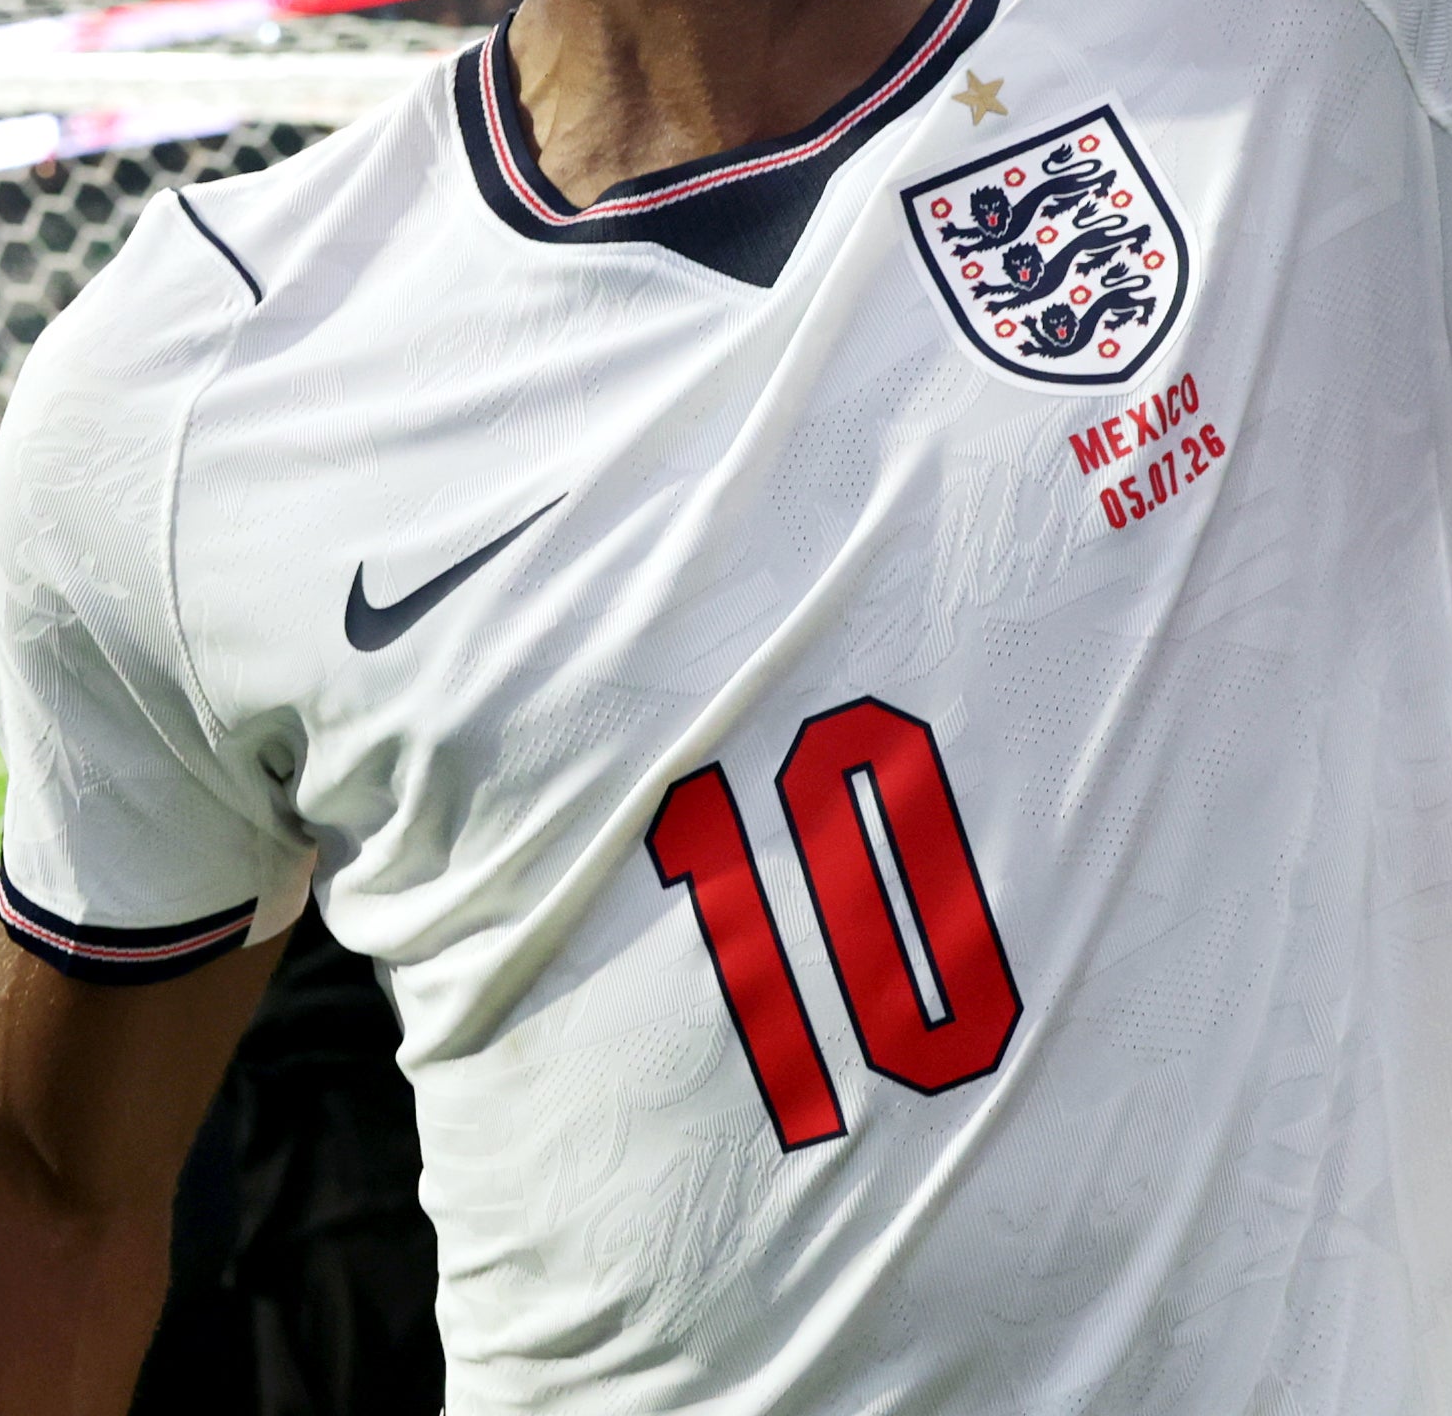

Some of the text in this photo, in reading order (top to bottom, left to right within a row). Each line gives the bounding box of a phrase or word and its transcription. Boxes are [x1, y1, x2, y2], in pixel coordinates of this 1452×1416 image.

[1068, 372, 1201, 474] MEXICO
[1099, 423, 1226, 530] 05.07.26
[643, 695, 1024, 1154] 10
